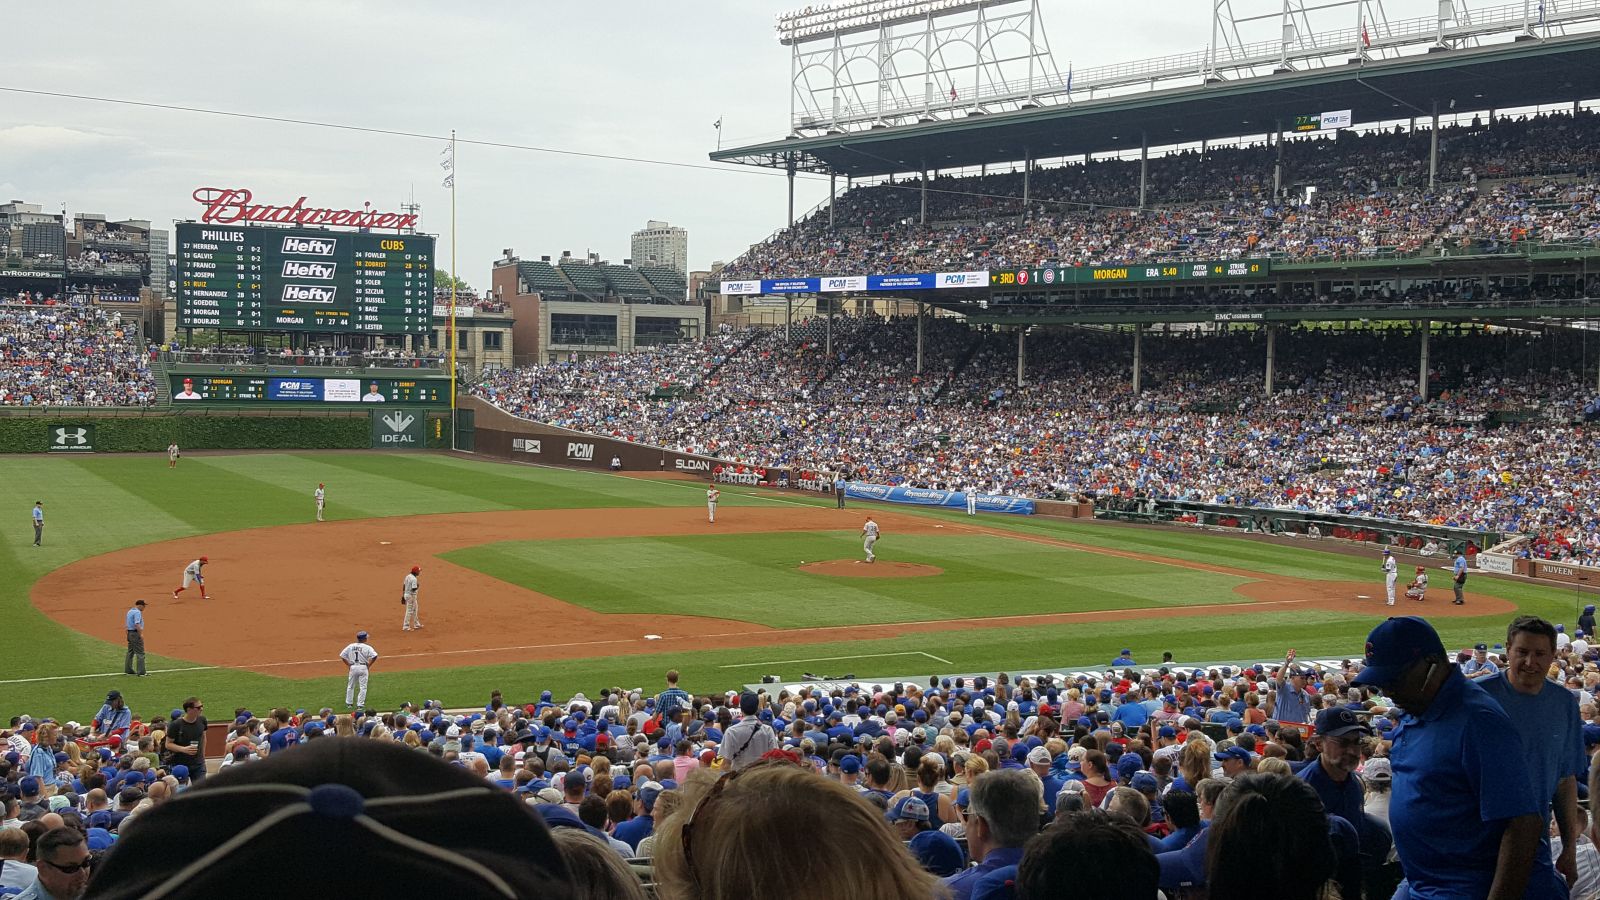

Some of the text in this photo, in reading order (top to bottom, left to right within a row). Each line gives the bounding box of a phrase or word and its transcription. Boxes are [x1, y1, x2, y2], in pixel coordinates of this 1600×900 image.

[193, 188, 418, 229] Budweiser
[202, 231, 244, 241] PHILLIES
[285, 239, 332, 255] Hefty
[381, 240, 404, 250] CUBS
[285, 263, 332, 279] Hefty
[1094, 269, 1127, 279] MORGAN
[1146, 267, 1177, 277] ERA 5.40
[945, 275, 965, 283] PCM
[1000, 273, 1014, 284] 3RD
[1033, 271, 1037, 282] 1
[1060, 270, 1064, 281] 1
[285, 287, 332, 302] Hefty
[567, 442, 594, 458] PCM
[675, 459, 710, 470] SLOAN
[904, 490, 929, 498] Reynolds
[1542, 566, 1573, 576] NUVEEN
[355, 652, 359, 662] 1
